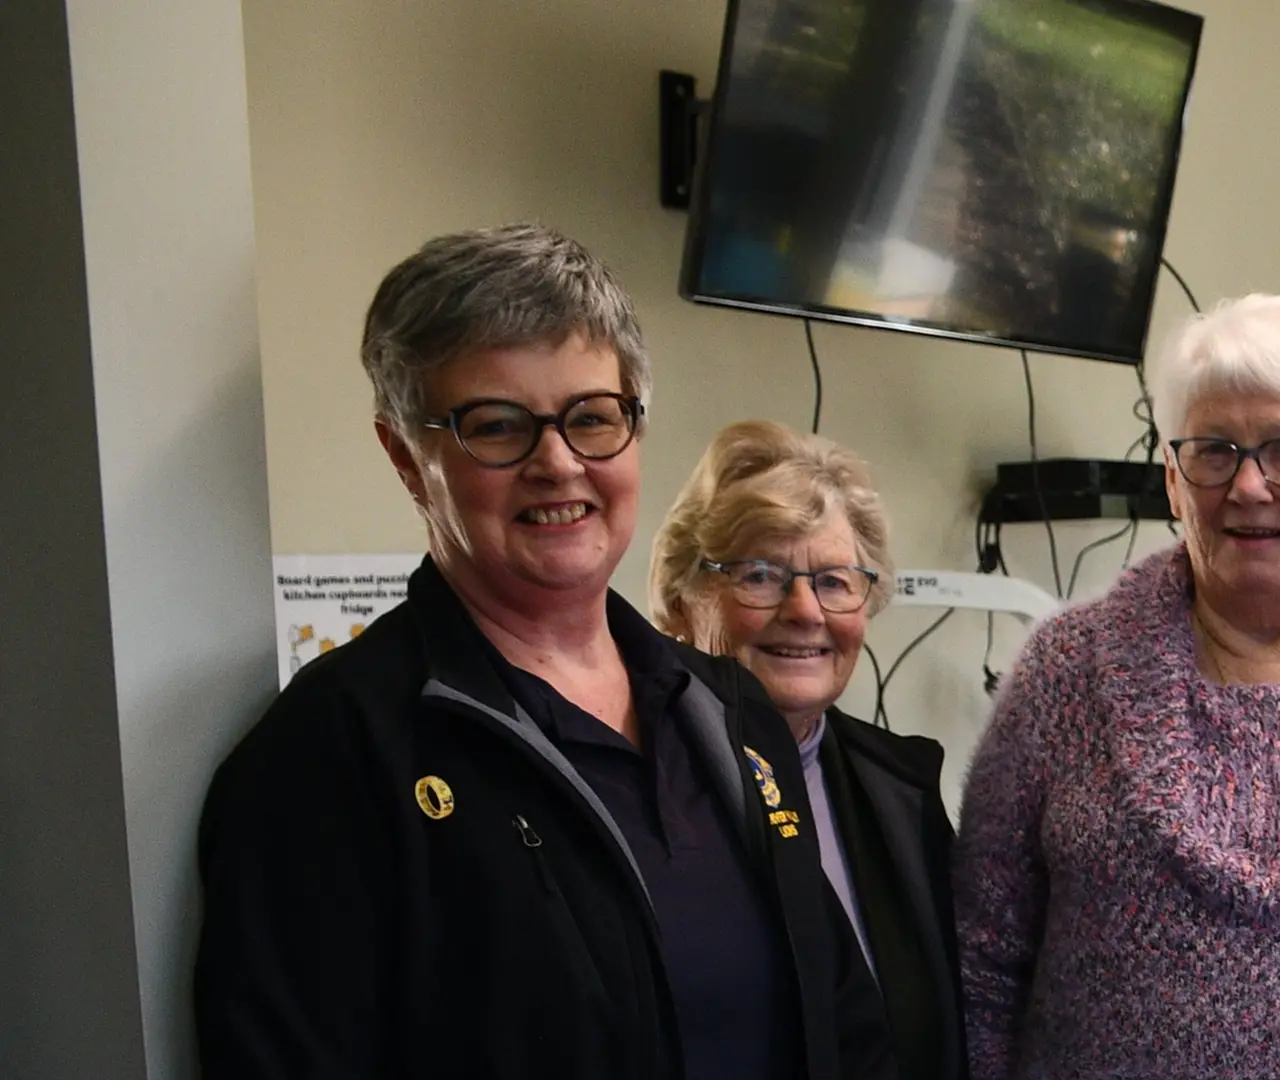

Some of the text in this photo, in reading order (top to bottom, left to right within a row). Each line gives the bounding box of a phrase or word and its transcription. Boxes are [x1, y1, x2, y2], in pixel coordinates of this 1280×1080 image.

[277, 574, 311, 585] Board
[315, 576, 350, 587] games
[354, 574, 374, 584] and
[283, 590, 326, 601] kitchen
[329, 588, 387, 602] cupboards
[340, 604, 373, 616] fridge
